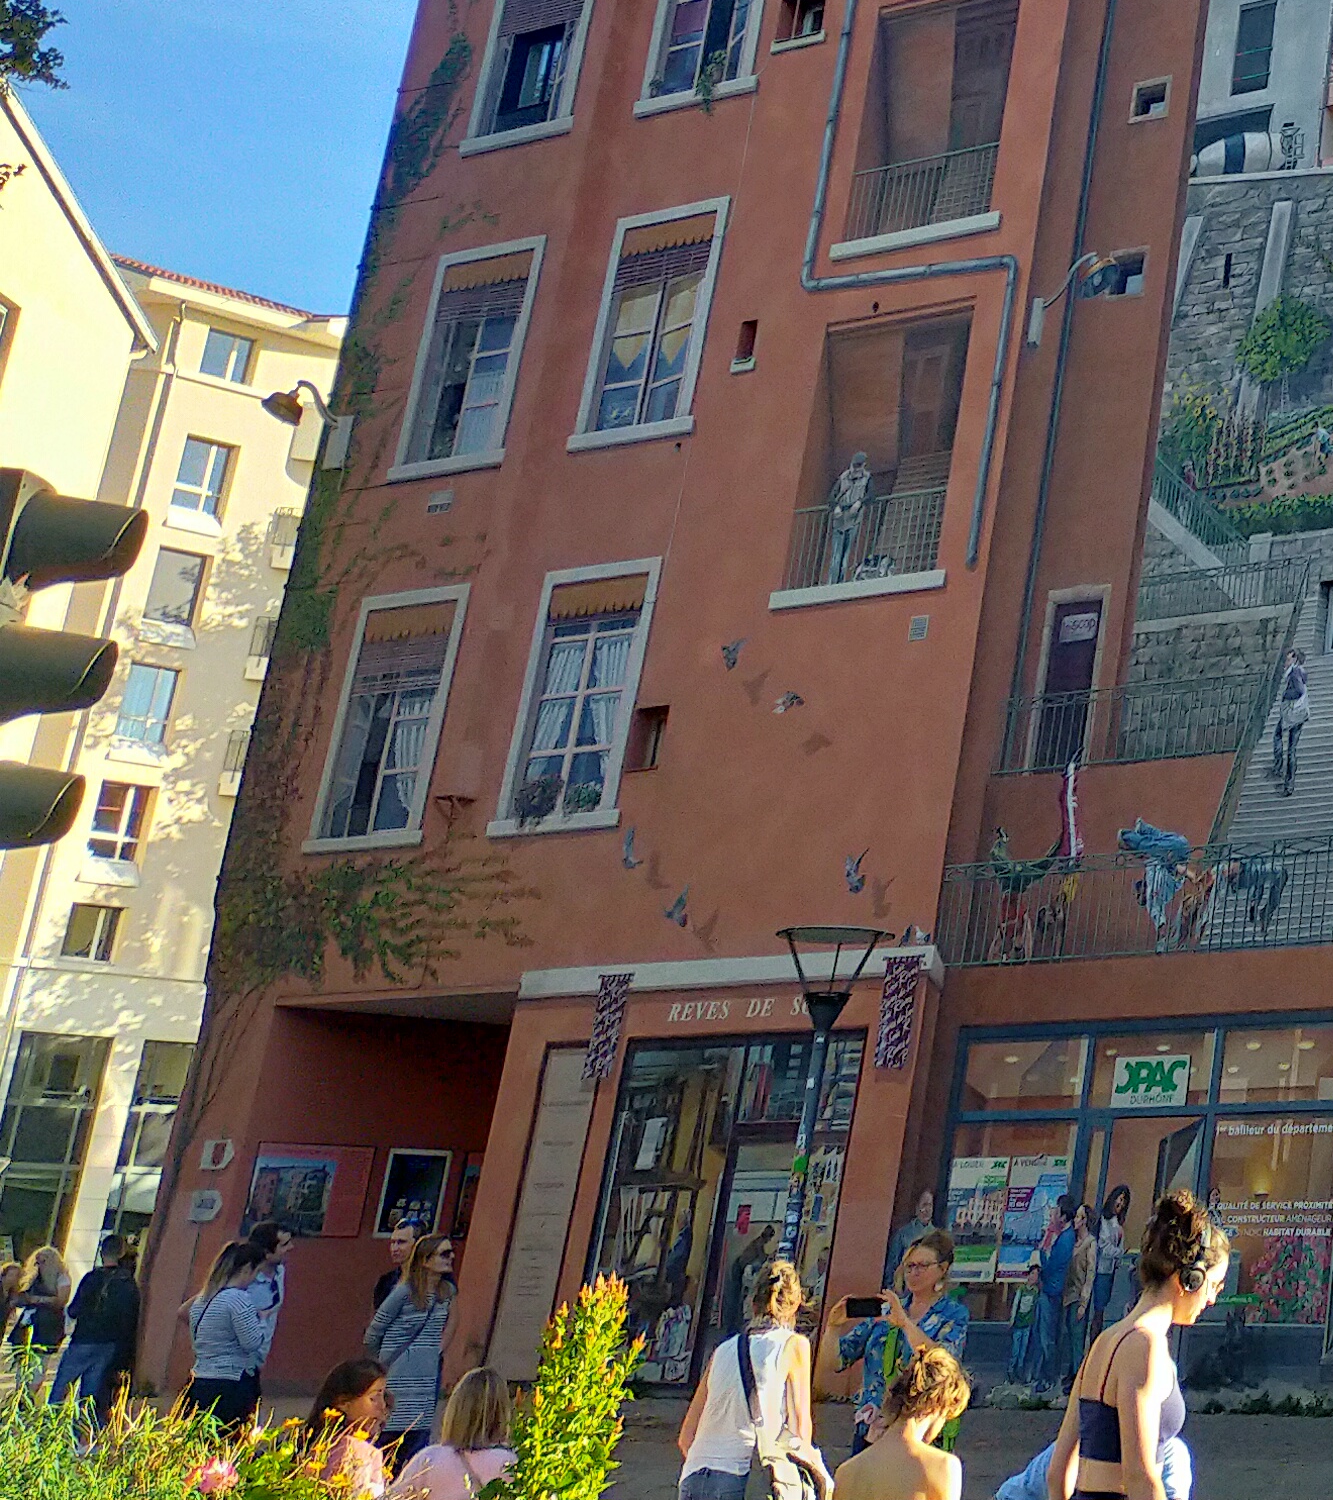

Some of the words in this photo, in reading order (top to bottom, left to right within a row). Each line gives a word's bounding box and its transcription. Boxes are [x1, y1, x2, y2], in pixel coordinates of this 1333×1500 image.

[667, 999, 731, 1023] REVES
[745, 997, 776, 1018] DE
[1267, 1123, 1280, 1134] du
[1249, 1201, 1260, 1210] DE
[1261, 1200, 1293, 1210] SERVICE
[1227, 1214, 1286, 1224] CONSTRUCTEUR
